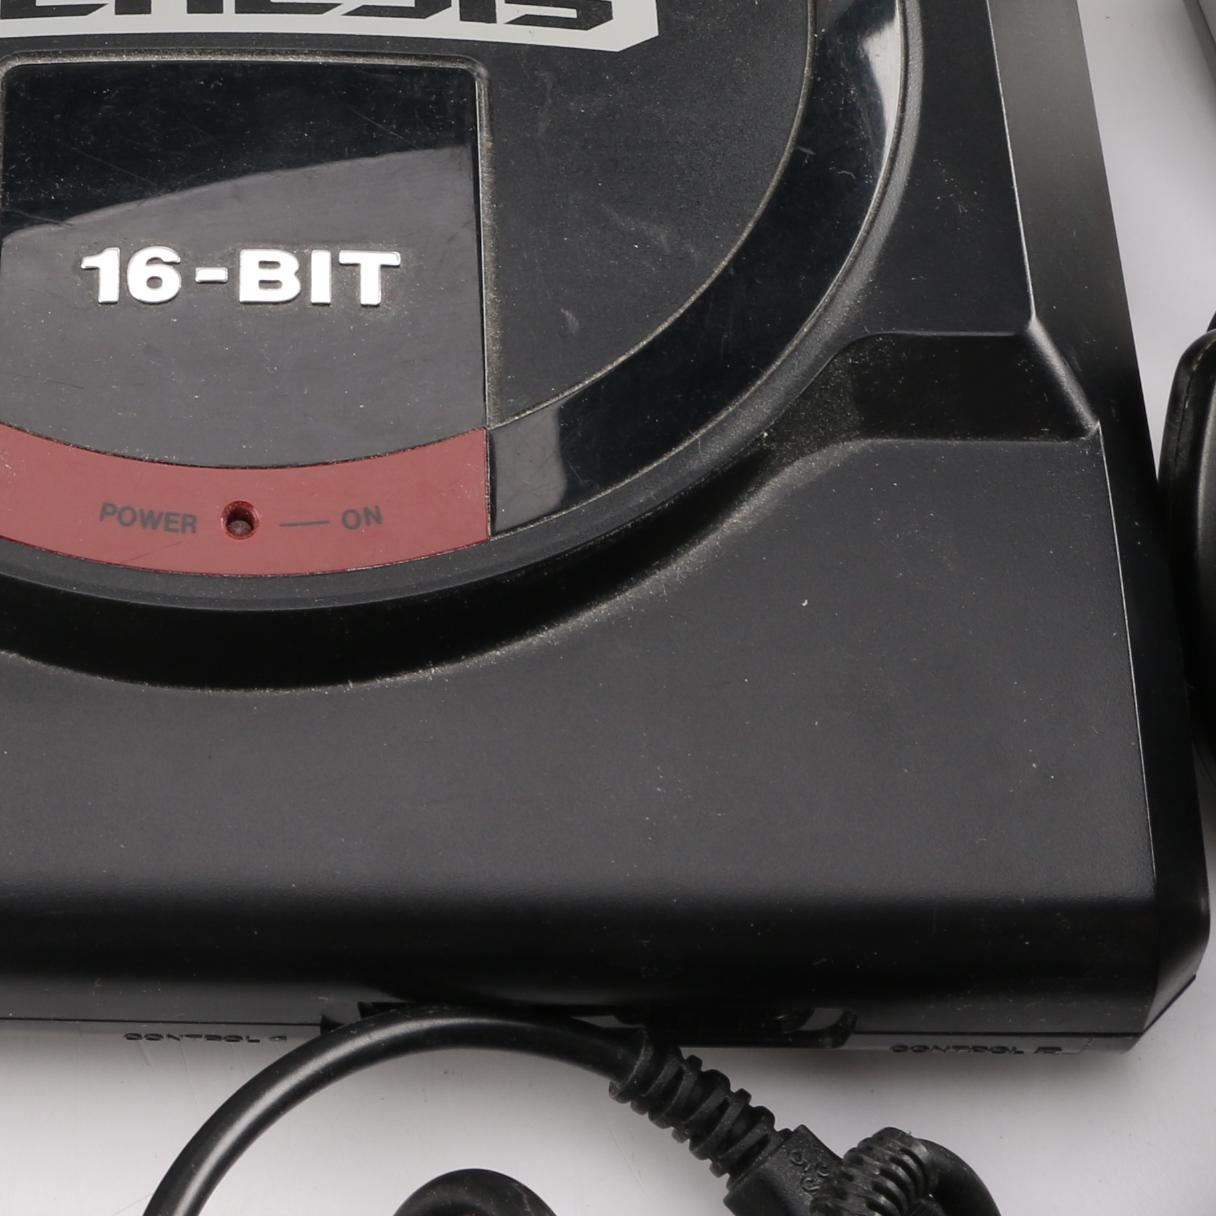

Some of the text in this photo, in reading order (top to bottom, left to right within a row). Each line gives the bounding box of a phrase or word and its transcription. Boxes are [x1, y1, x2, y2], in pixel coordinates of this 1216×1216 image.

[80, 246, 402, 308] 16-BIT
[98, 503, 384, 536] POWER ON
